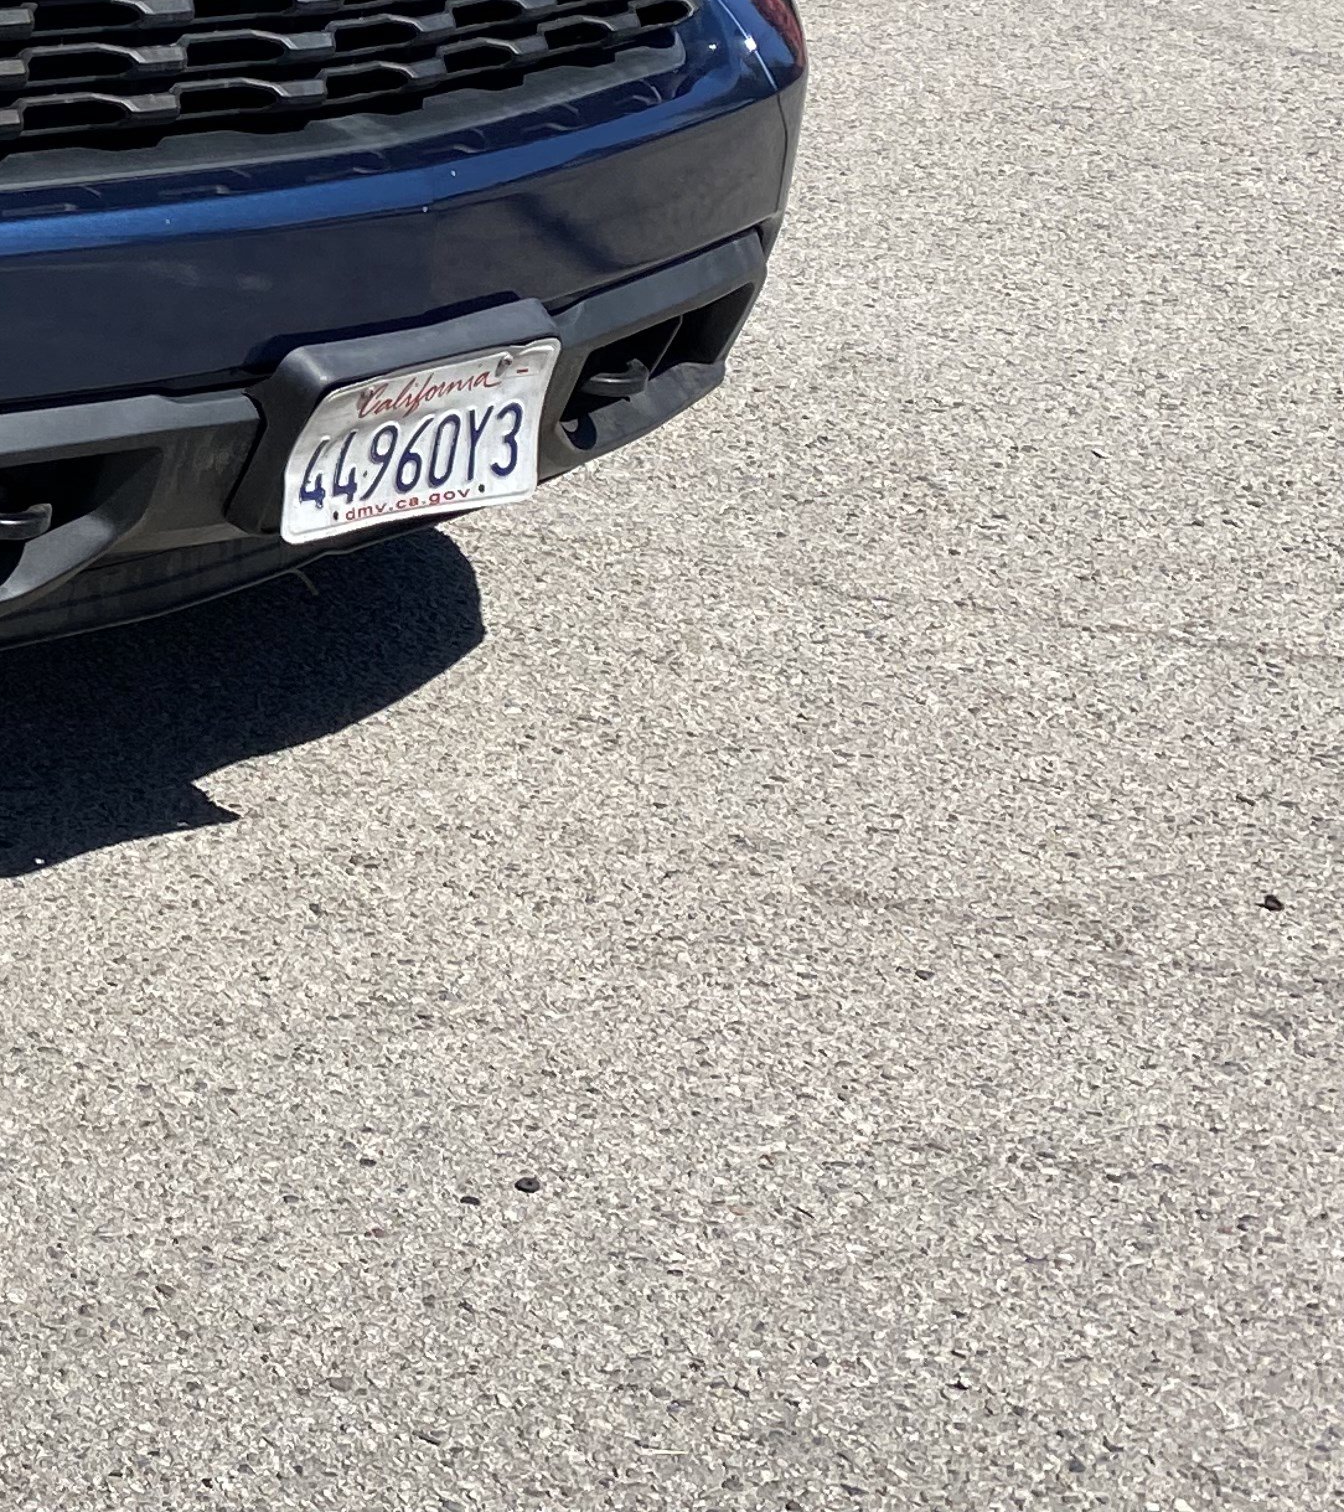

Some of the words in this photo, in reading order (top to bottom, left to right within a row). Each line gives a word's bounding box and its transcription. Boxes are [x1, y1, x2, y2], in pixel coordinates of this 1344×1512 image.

[357, 370, 500, 419] California
[299, 401, 523, 509] 44960Y3
[344, 486, 471, 522] dmv.ca.gov
